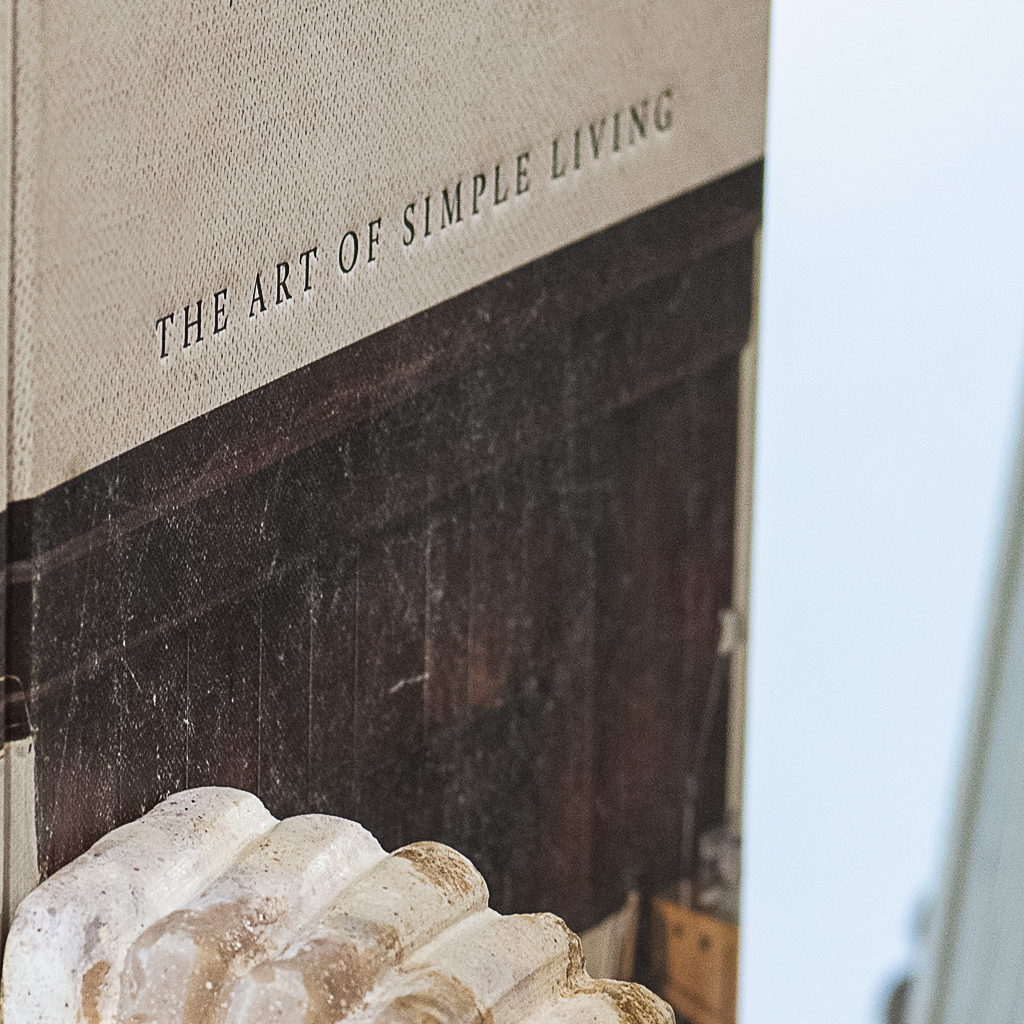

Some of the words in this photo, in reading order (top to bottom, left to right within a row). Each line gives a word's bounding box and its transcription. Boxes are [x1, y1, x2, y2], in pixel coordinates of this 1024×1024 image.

[155, 288, 228, 359] THE
[248, 246, 318, 318] ART
[338, 217, 382, 274] OF
[402, 151, 530, 247] SIMPLE
[551, 88, 674, 180] LIVING
